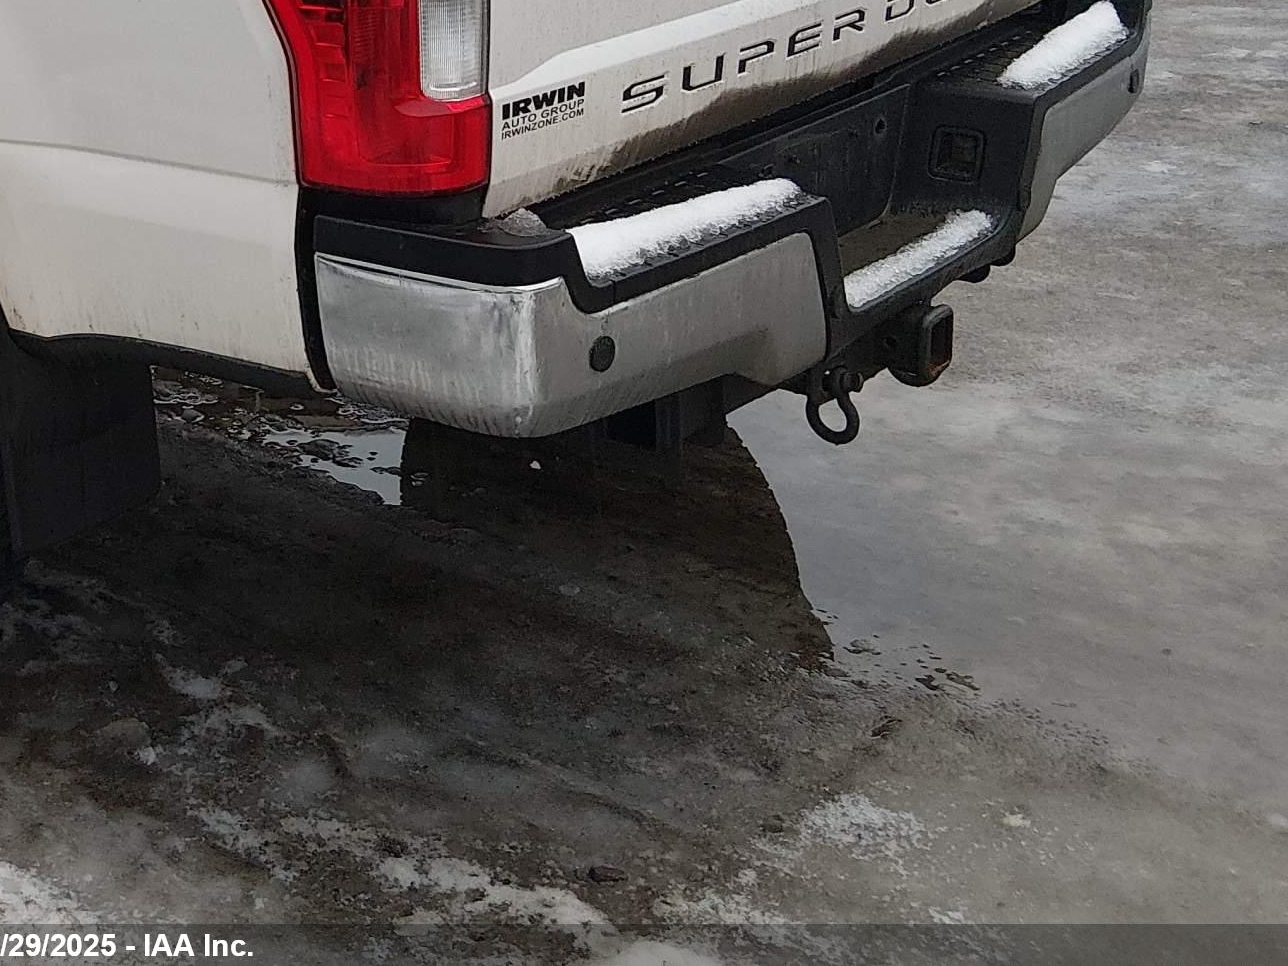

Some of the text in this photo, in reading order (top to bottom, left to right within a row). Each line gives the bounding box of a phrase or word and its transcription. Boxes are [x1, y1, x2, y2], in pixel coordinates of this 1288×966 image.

[621, 7, 867, 114] SUPER
[501, 99, 584, 131] AUTO GROUP
[502, 81, 586, 121] IRWIN
[501, 108, 584, 140] IRWINZONE.COM
